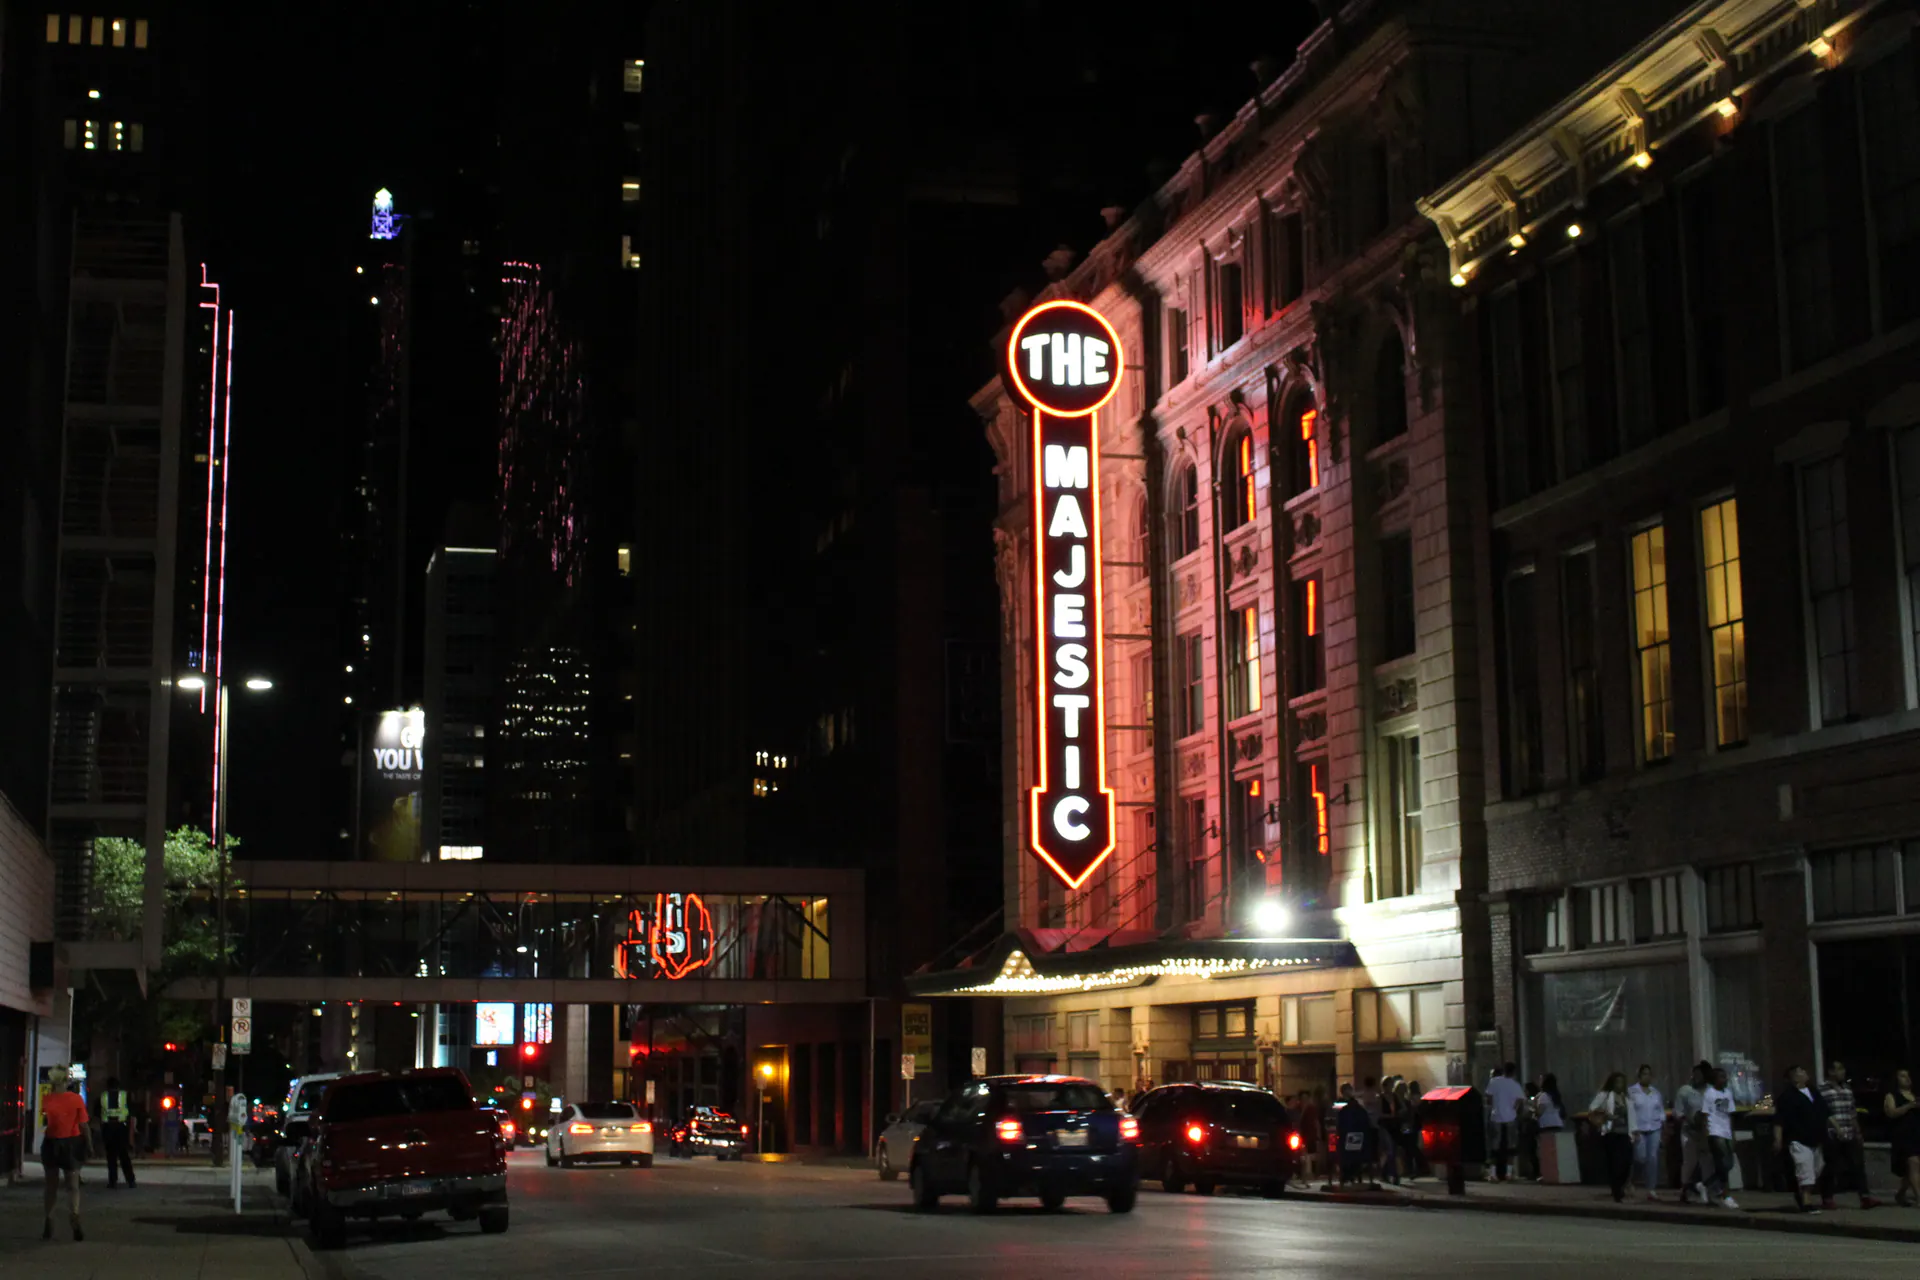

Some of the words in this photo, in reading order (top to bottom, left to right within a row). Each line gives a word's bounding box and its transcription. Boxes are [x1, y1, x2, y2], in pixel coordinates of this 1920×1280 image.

[1021, 333, 1109, 386] THE
[1044, 444, 1091, 842] MAJESTIC
[373, 748, 412, 770] YOU
